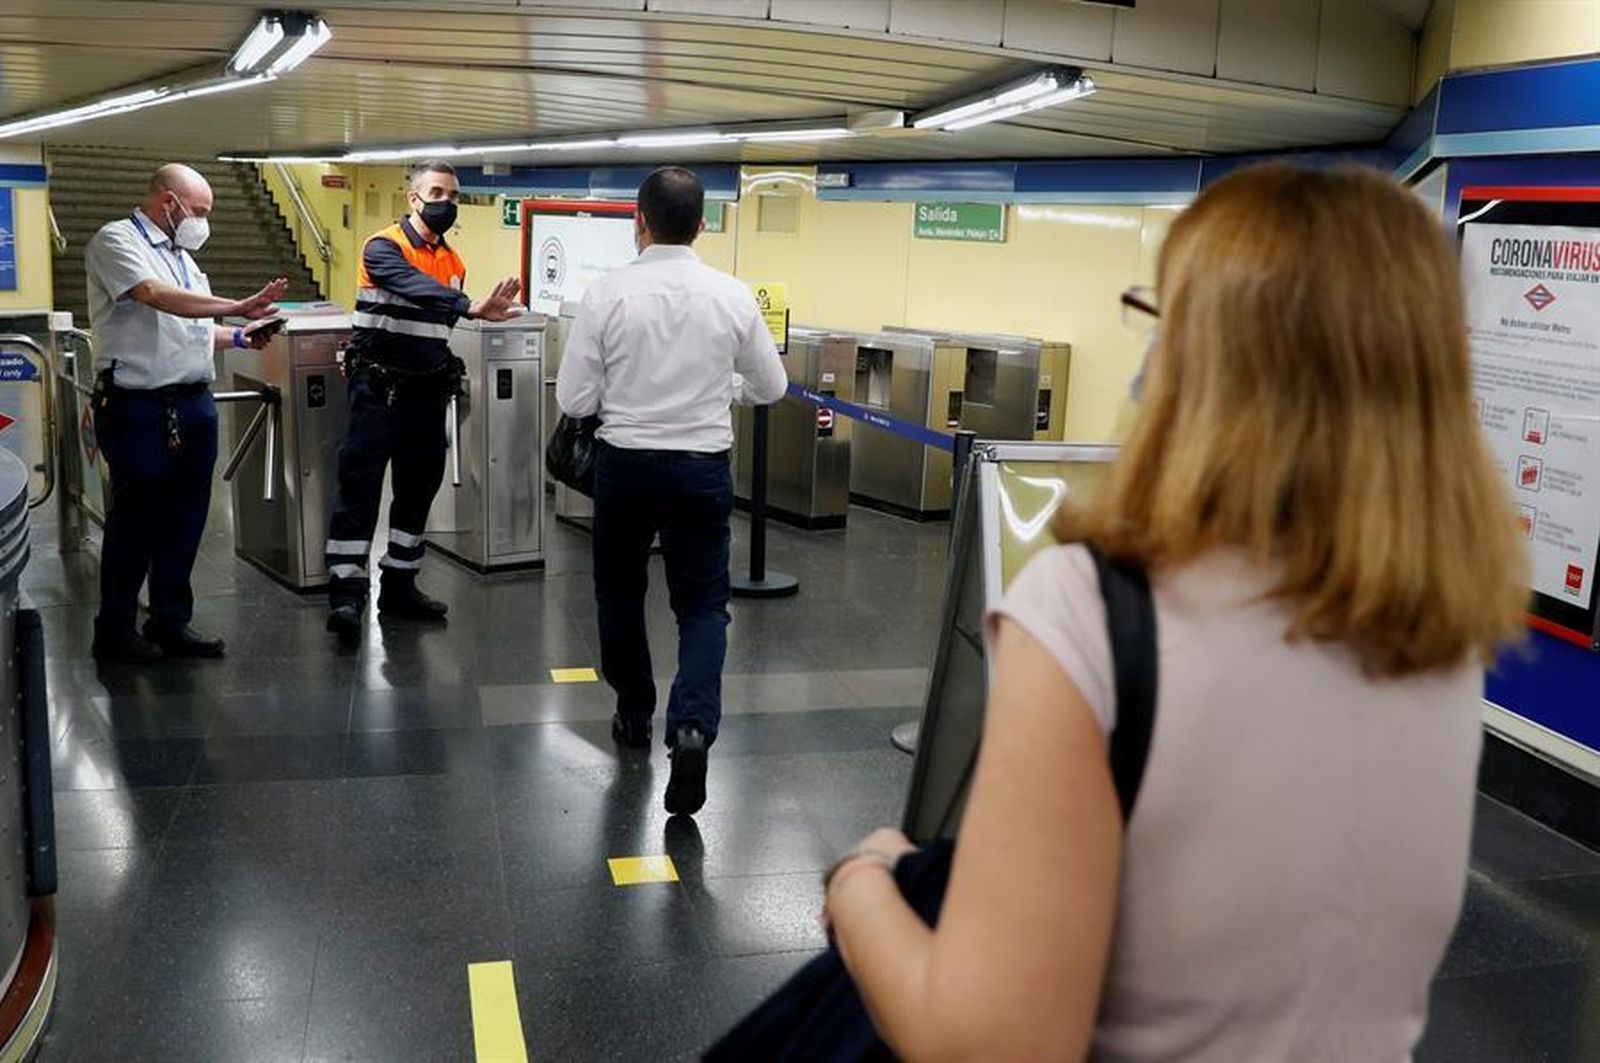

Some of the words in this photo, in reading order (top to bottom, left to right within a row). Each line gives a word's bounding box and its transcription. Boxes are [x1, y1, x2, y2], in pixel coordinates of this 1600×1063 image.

[918, 205, 958, 223] Salida
[1491, 238, 1600, 271] CORONAVIRUS
[1490, 267, 1547, 280] RECOMENDACIONES
[1547, 271, 1564, 281] PARA
[1566, 273, 1590, 284] VIAJAR
[1590, 274, 1600, 284] EN
